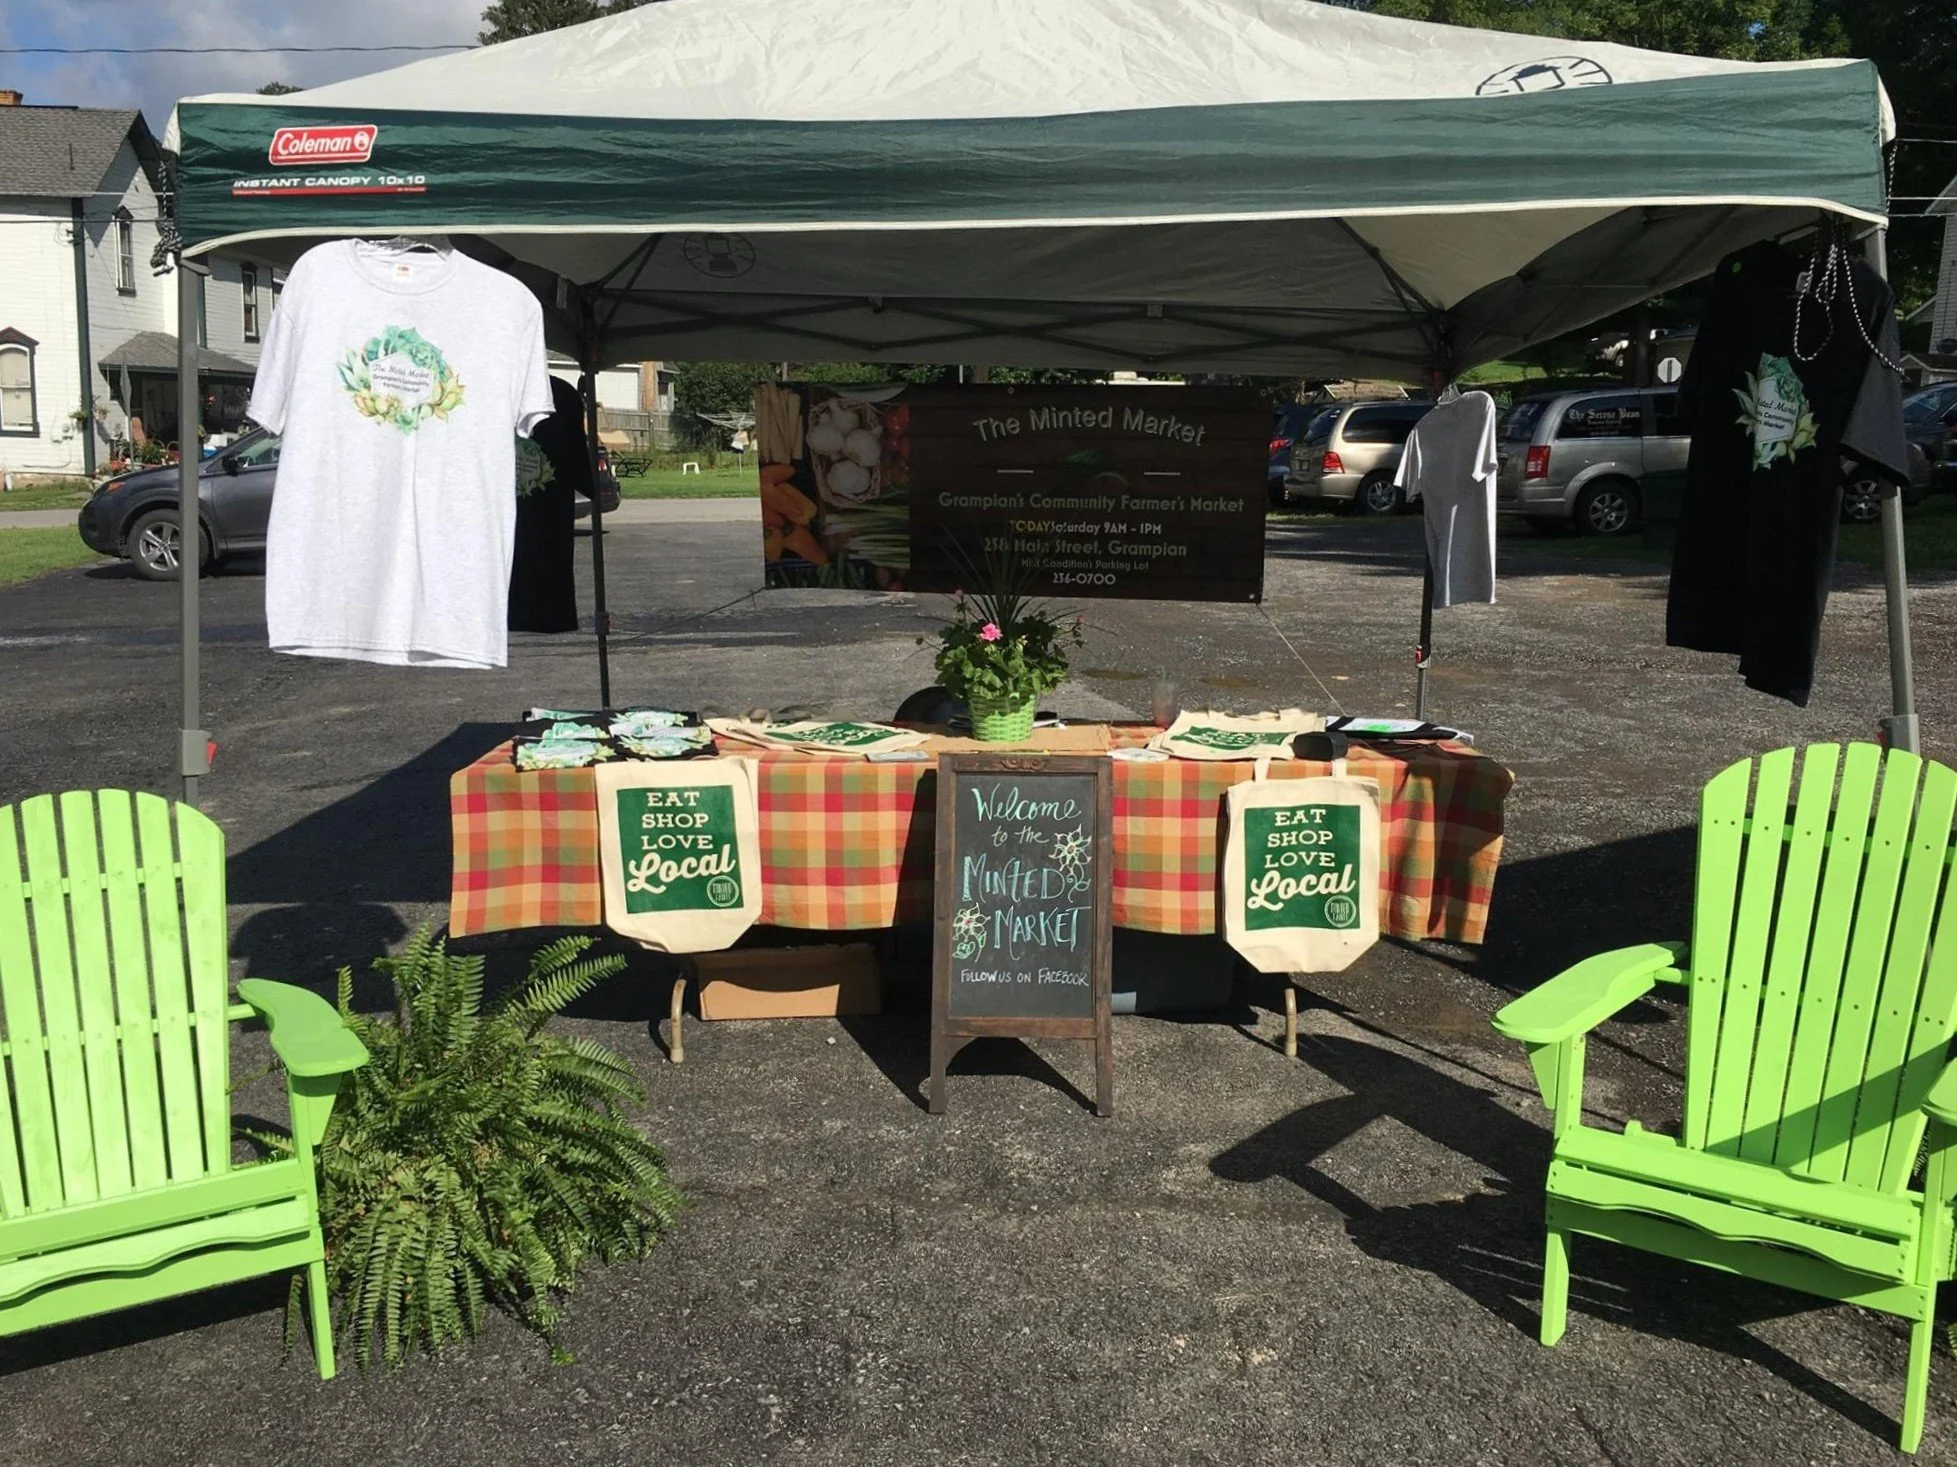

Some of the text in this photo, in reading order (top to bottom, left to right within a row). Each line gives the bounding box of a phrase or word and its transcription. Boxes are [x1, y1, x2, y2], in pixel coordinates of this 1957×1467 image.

[277, 132, 351, 155] Coleman
[233, 176, 426, 188] INSTANT CANOPY 10x10
[972, 406, 1205, 446] The Minted Market
[939, 492, 1244, 512] Grampian's Community Farmer's Market
[1103, 522, 1127, 533] 9AM
[1140, 523, 1162, 534] 1PM
[1014, 538, 1049, 552] Main
[1107, 540, 1187, 559] Grampian
[1096, 560, 1130, 571] Parking
[1133, 561, 1149, 570] Lot
[1052, 572, 1116, 585] 236-0700
[647, 791, 700, 806] EAT
[971, 784, 1082, 822] Welcome
[641, 813, 709, 828] SHOP
[1274, 808, 1326, 826] EAT
[641, 834, 713, 850] LOVE
[992, 826, 1049, 847] to the
[1267, 830, 1333, 848] SHOP
[627, 843, 736, 894] Local
[1264, 851, 1335, 868] LOVE
[1247, 863, 1356, 911] Local
[993, 906, 1091, 960] MARKET
[1016, 971, 1031, 983] ON
[1038, 967, 1089, 987] FACEBOOK
